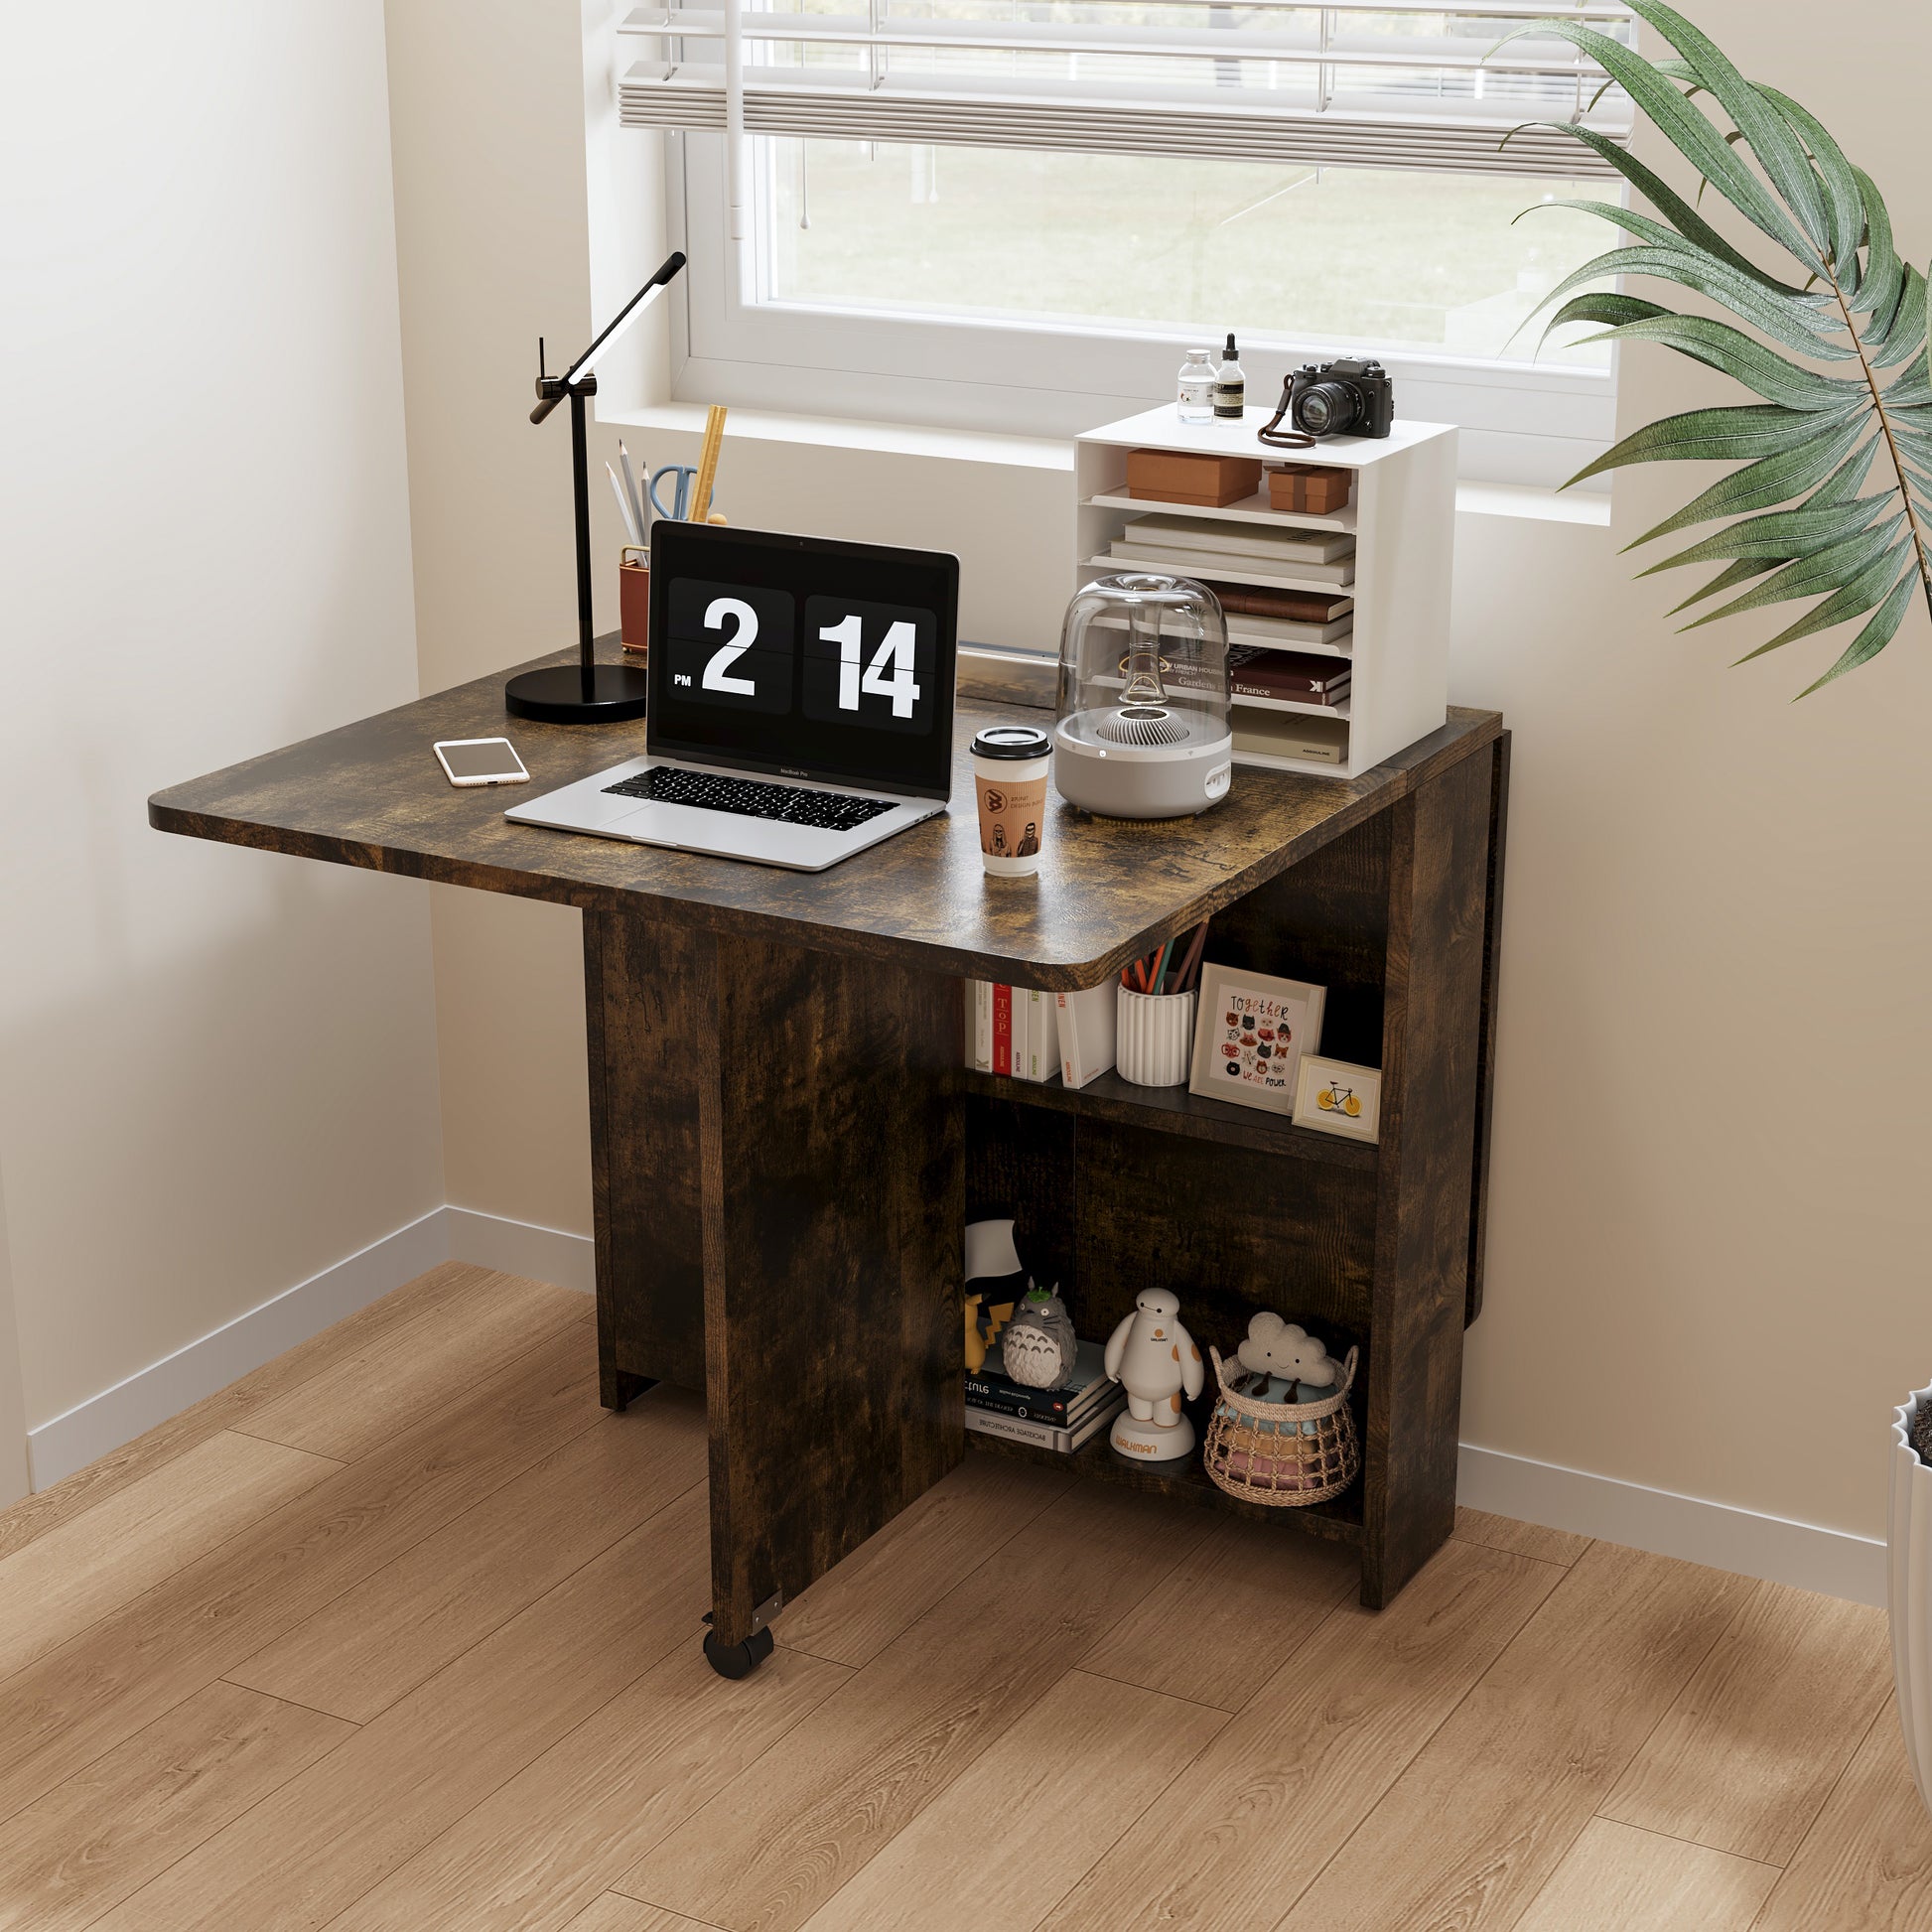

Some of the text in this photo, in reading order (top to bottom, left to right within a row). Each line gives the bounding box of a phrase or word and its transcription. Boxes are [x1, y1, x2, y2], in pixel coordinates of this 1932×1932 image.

[702, 598, 920, 719] 2 14
[1173, 662, 1198, 672] URBAN
[674, 674, 692, 687] PM
[1178, 676, 1216, 691] Gardens
[1236, 683, 1271, 697] France
[780, 767, 799, 776] MacBook
[1116, 1435, 1158, 1454] WALKMAN
